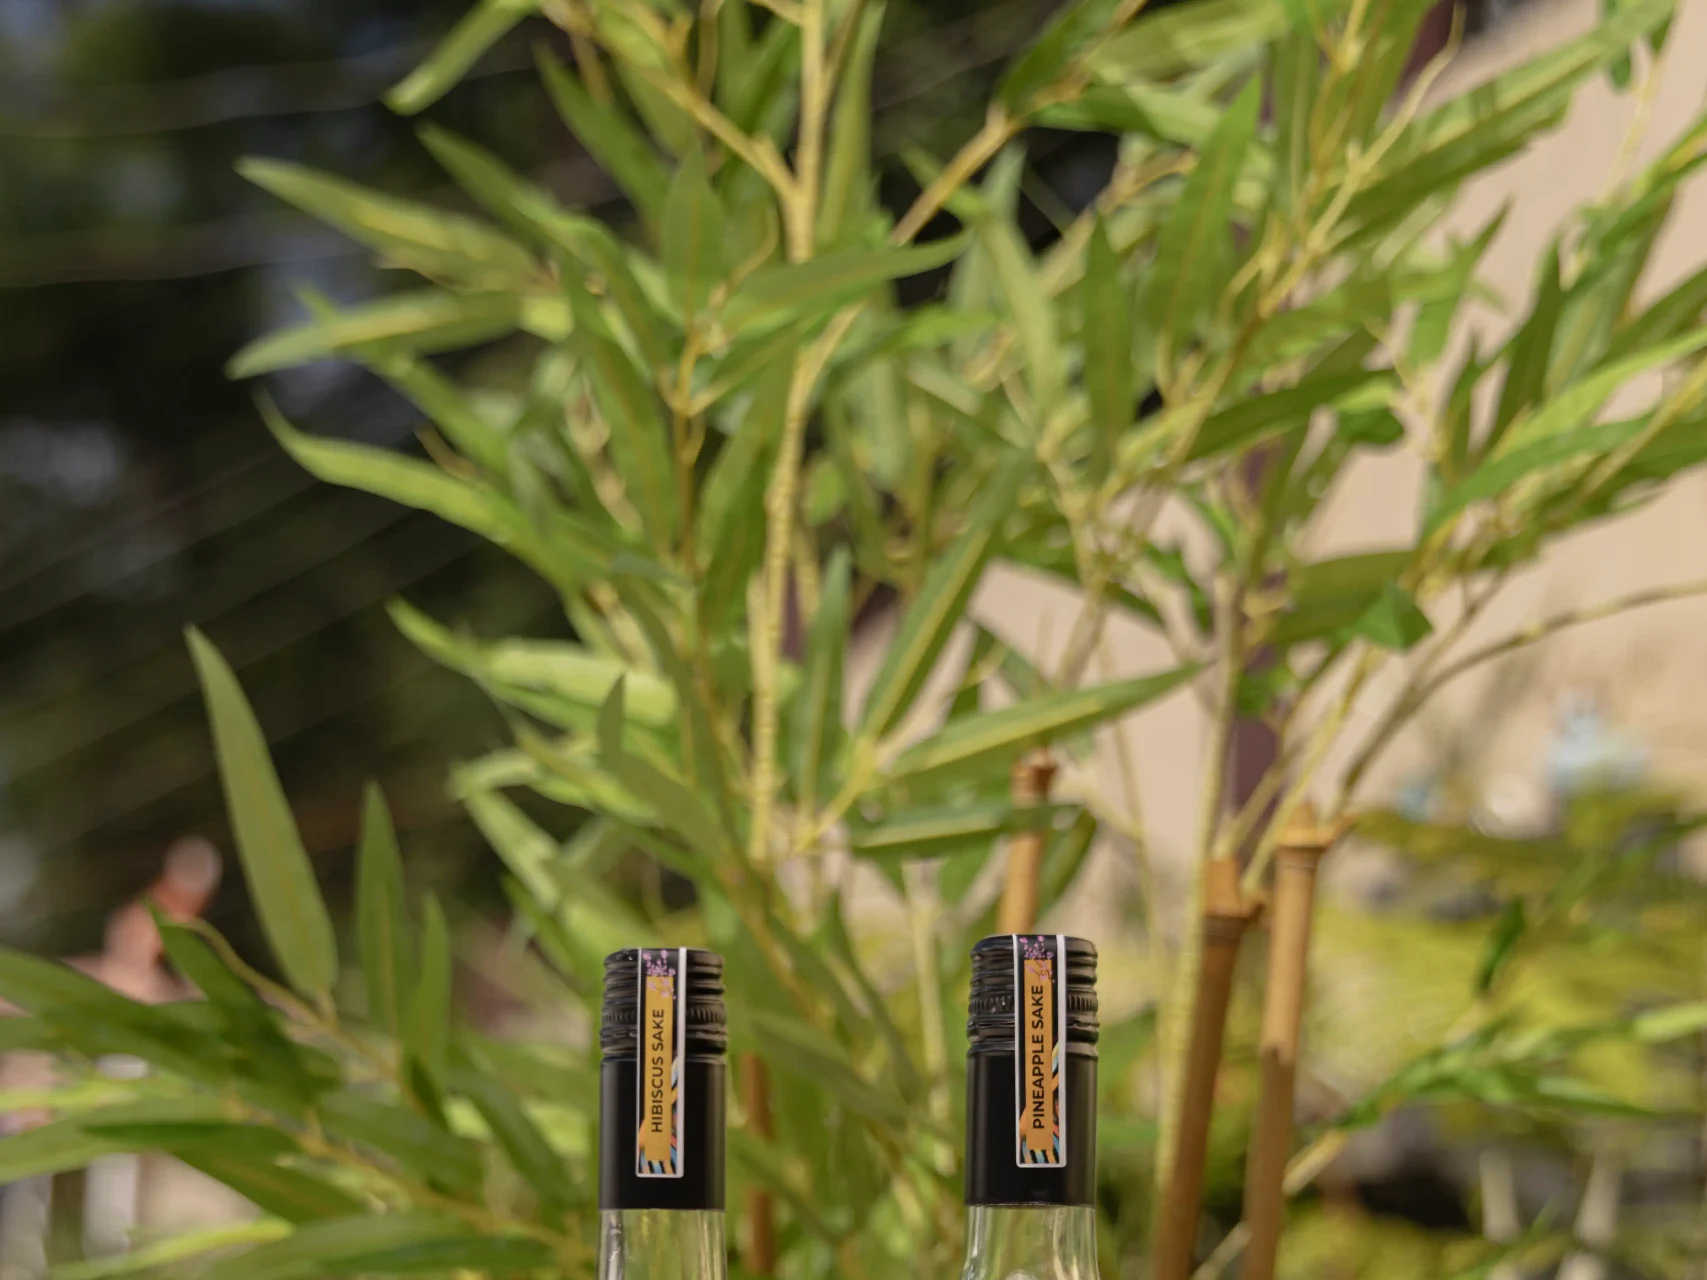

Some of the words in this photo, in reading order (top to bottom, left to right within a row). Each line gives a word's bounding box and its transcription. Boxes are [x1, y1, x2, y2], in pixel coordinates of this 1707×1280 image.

[652, 1008, 665, 1053] SAKE
[1031, 984, 1045, 1030] SAKE
[651, 1057, 664, 1134] HIBISCUS
[1031, 1034, 1045, 1130] PINEAPPLE
